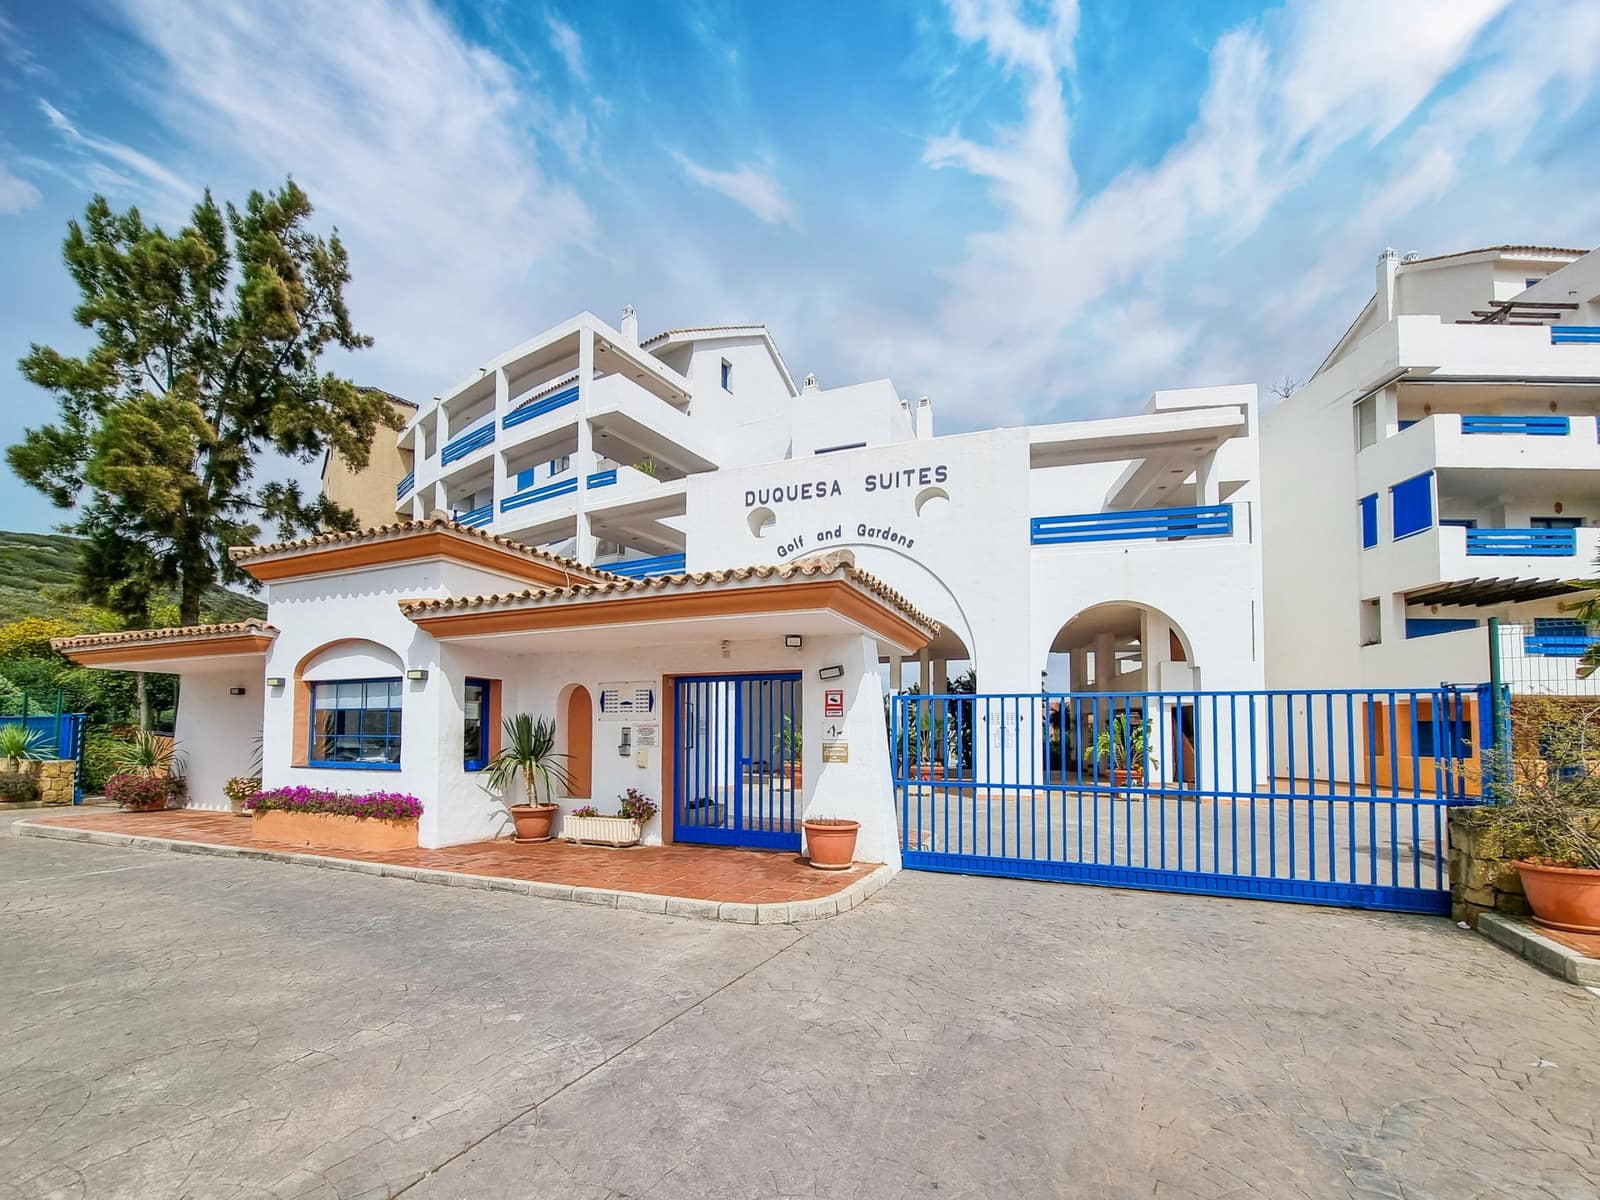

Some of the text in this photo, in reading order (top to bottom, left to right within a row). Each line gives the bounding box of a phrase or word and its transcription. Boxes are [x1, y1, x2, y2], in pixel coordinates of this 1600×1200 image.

[745, 465, 949, 507] DUQUESA SUITES
[777, 523, 915, 558] Golf and Gardens
